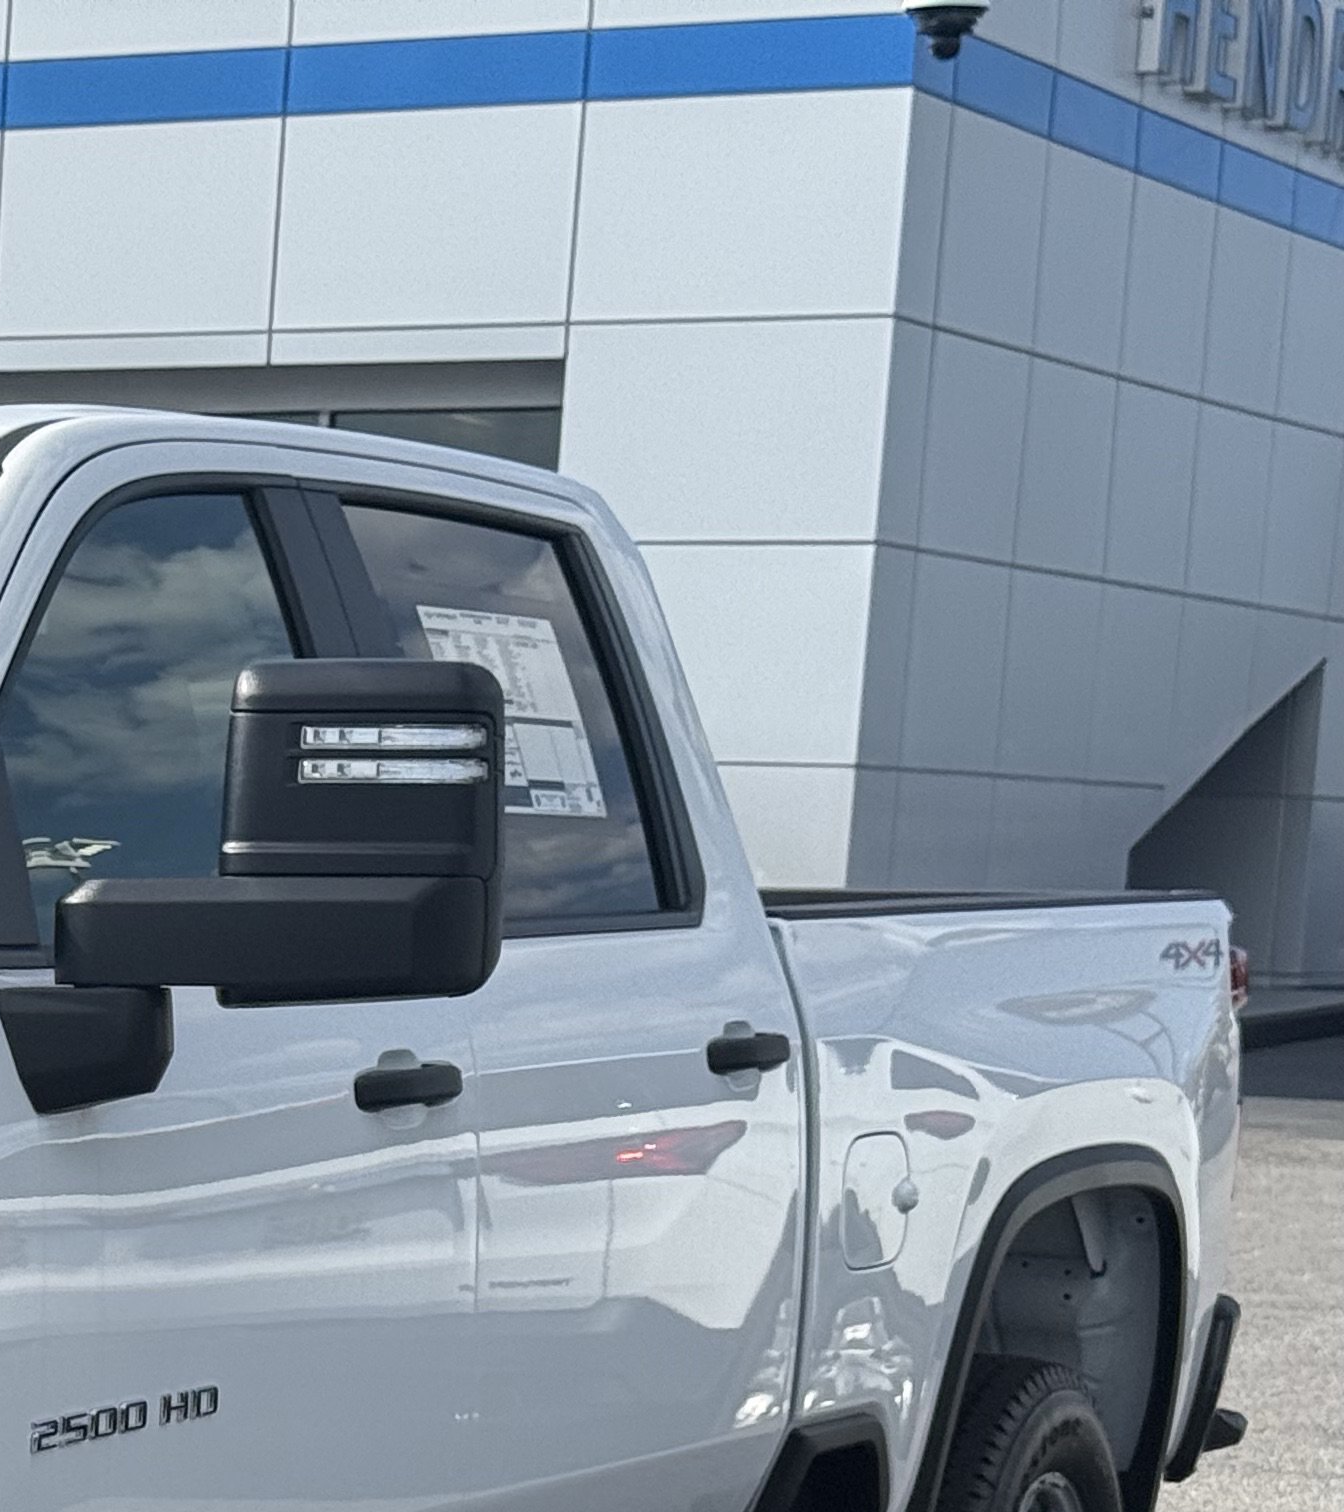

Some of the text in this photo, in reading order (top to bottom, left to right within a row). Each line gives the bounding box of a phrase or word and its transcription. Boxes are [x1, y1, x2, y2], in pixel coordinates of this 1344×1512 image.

[1135, 0, 1344, 147] HEND
[30, 1385, 218, 1454] 2500 HD
